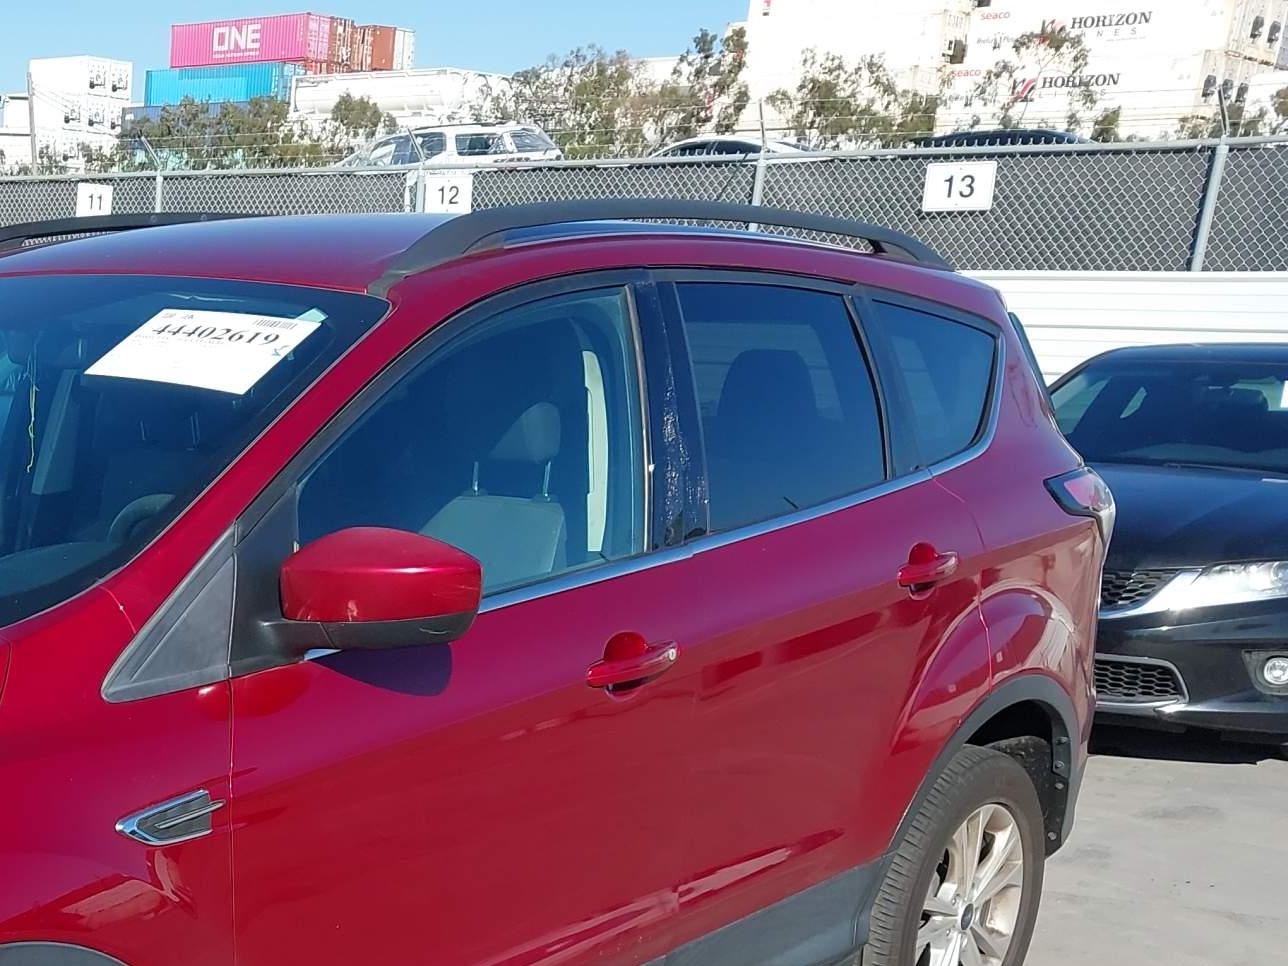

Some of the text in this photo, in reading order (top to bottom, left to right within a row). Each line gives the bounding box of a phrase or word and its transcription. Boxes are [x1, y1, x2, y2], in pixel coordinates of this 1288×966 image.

[981, 12, 1010, 20] seaco
[1070, 11, 1152, 29] HORIZON
[213, 24, 261, 51] ONE
[1041, 73, 1120, 89] HORIZON
[438, 186, 459, 204] 12
[943, 175, 975, 198] 13
[89, 193, 102, 211] 11
[153, 323, 280, 345] 44402619
